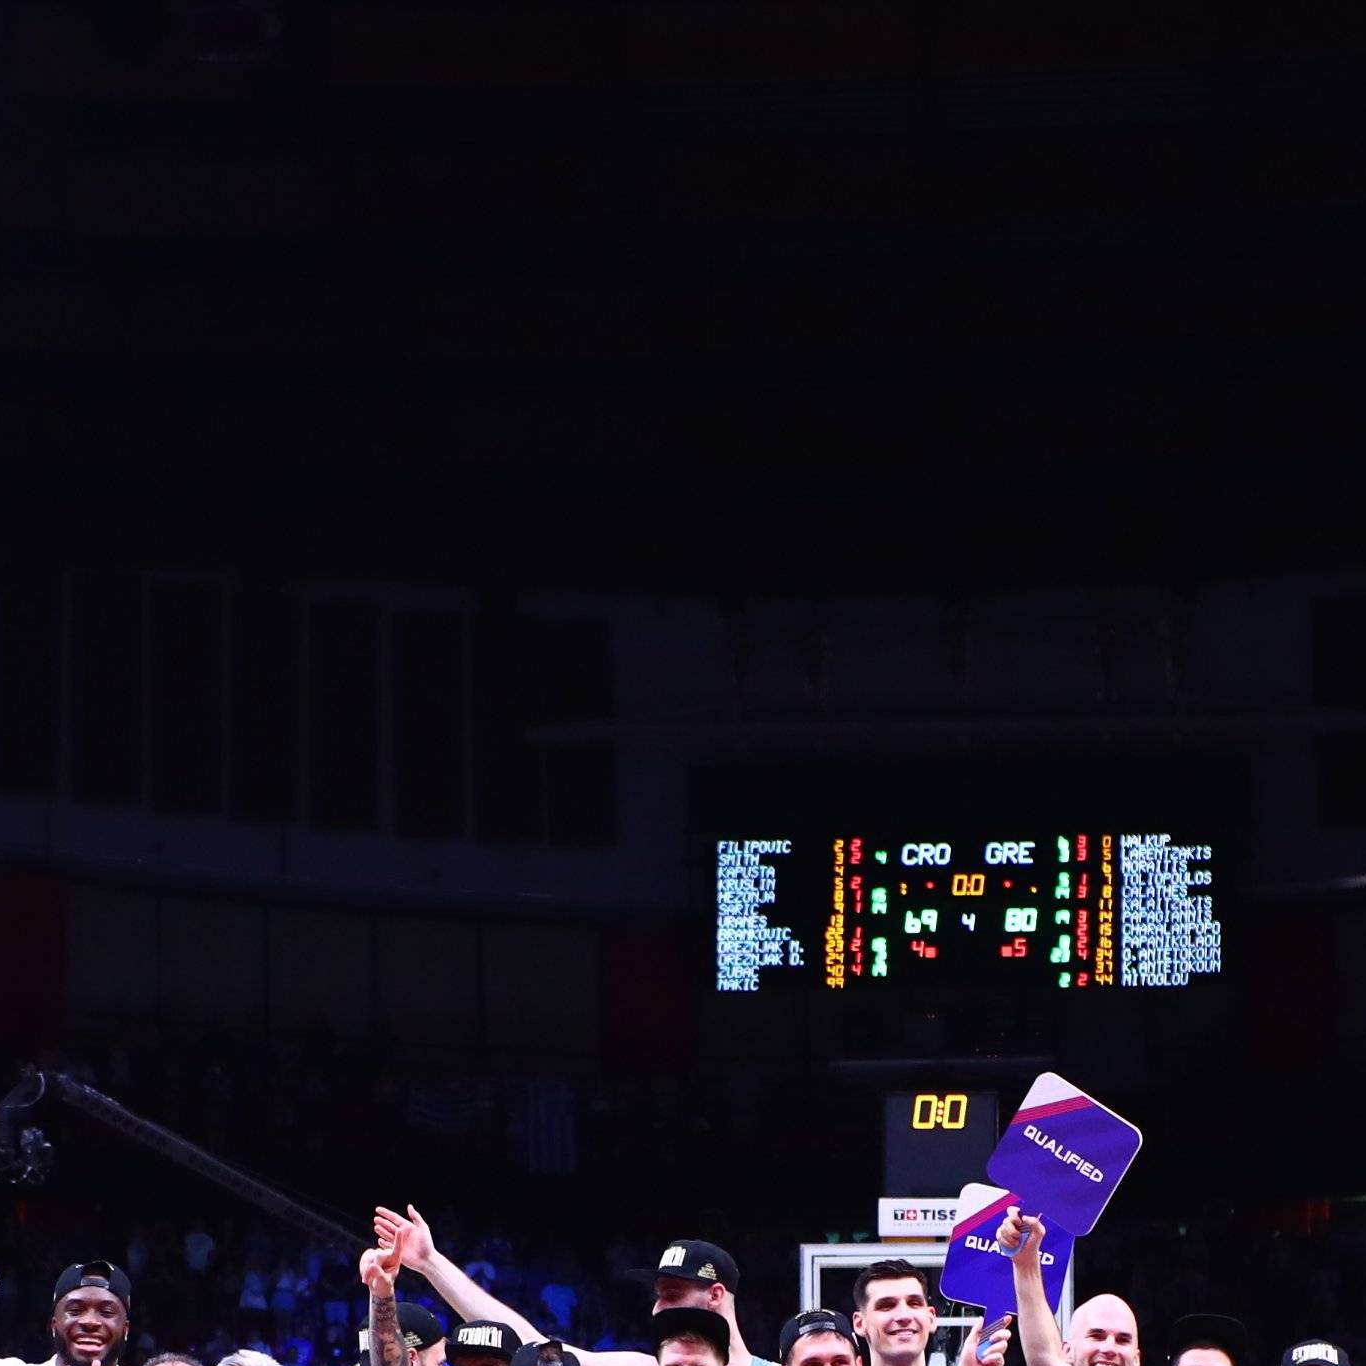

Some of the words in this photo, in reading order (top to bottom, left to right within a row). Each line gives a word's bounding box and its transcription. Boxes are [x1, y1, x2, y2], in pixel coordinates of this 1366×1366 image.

[717, 841, 792, 854] FILIPOVIC
[901, 843, 952, 866] CRO
[985, 841, 1036, 865] GRE
[717, 866, 775, 878] KAPUSTA
[904, 909, 939, 934] 69
[961, 913, 976, 931] 4
[1005, 907, 1038, 933] 80
[1014, 938, 1027, 957] 5
[1024, 1124, 1103, 1184] QUALIFIED
[920, 1209, 957, 1221] TISS
